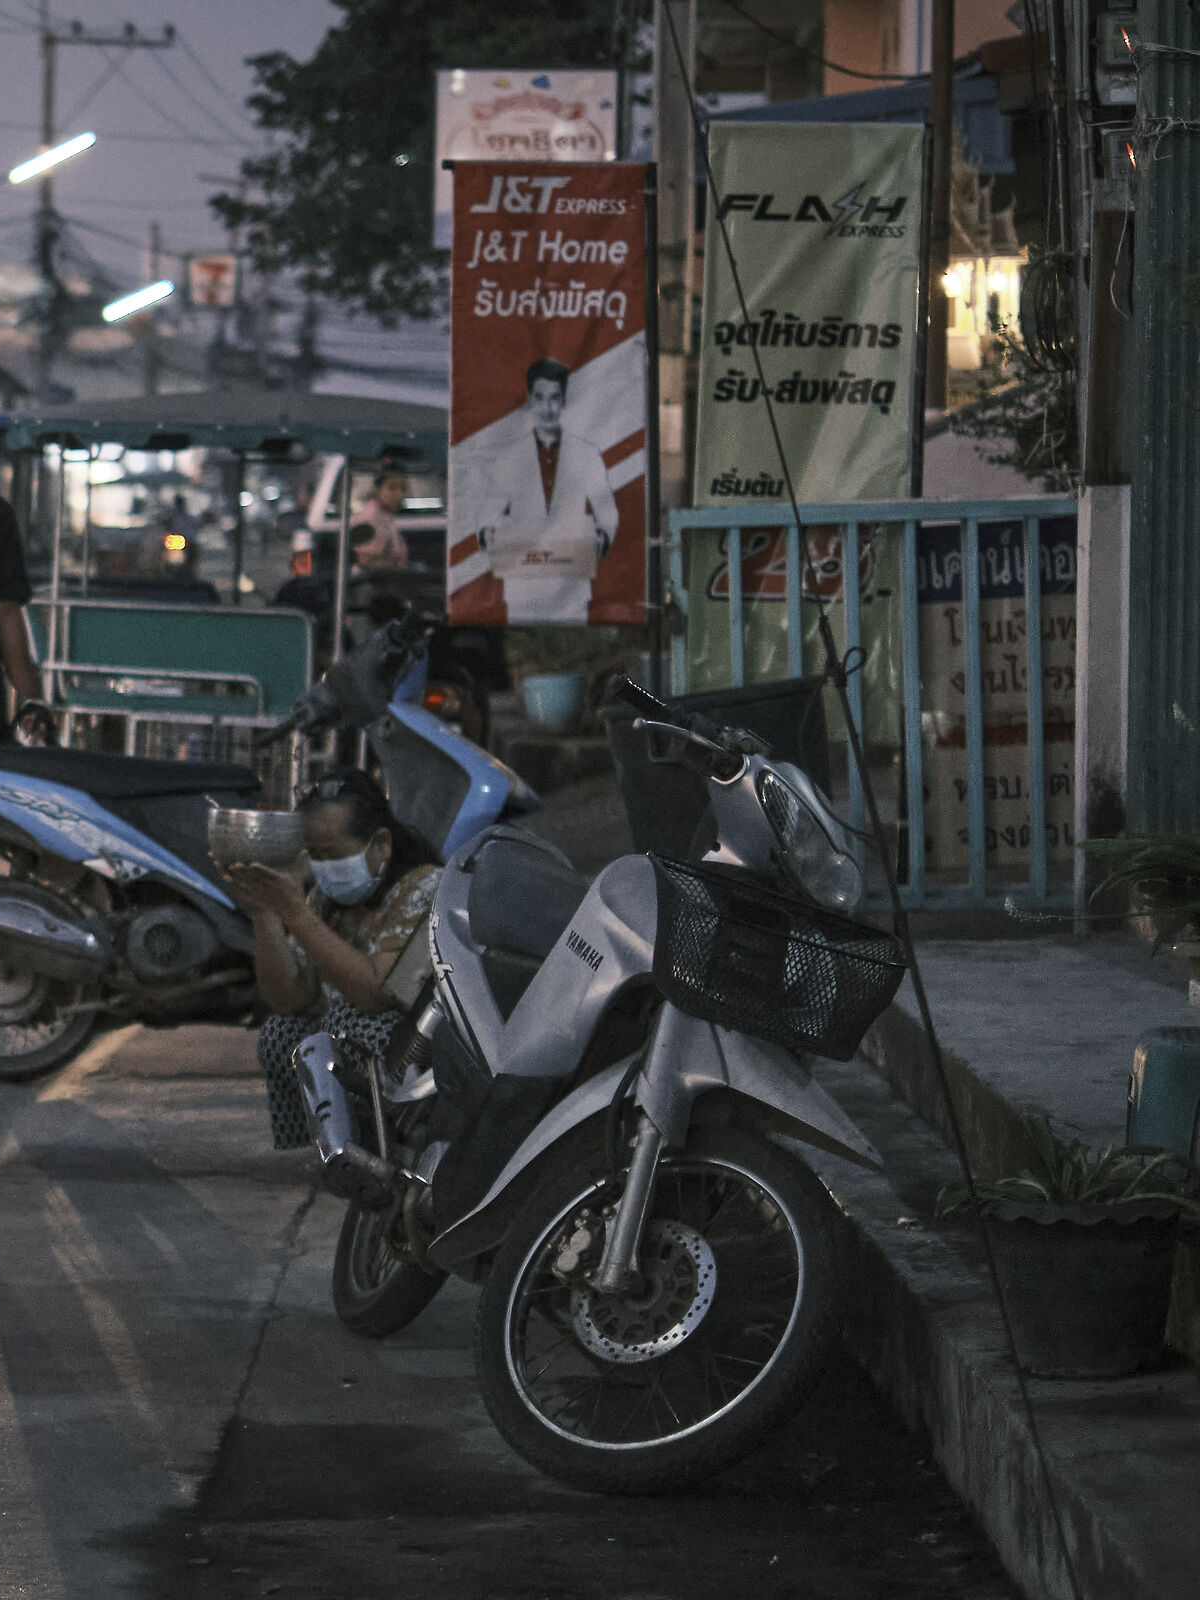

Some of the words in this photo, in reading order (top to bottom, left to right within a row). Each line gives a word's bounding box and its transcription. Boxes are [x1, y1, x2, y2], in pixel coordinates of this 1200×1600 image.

[470, 175, 572, 214] J&T
[554, 198, 628, 215] EXPRESS
[466, 229, 528, 270] J&T
[537, 229, 629, 265] Home
[836, 225, 906, 239] EXPRESS
[473, 276, 628, 331] รับส่งพัสดุ
[713, 308, 903, 356] จุดให้บริการ
[710, 467, 785, 497] เริ่มต้น
[566, 930, 603, 972] YAMAHA
